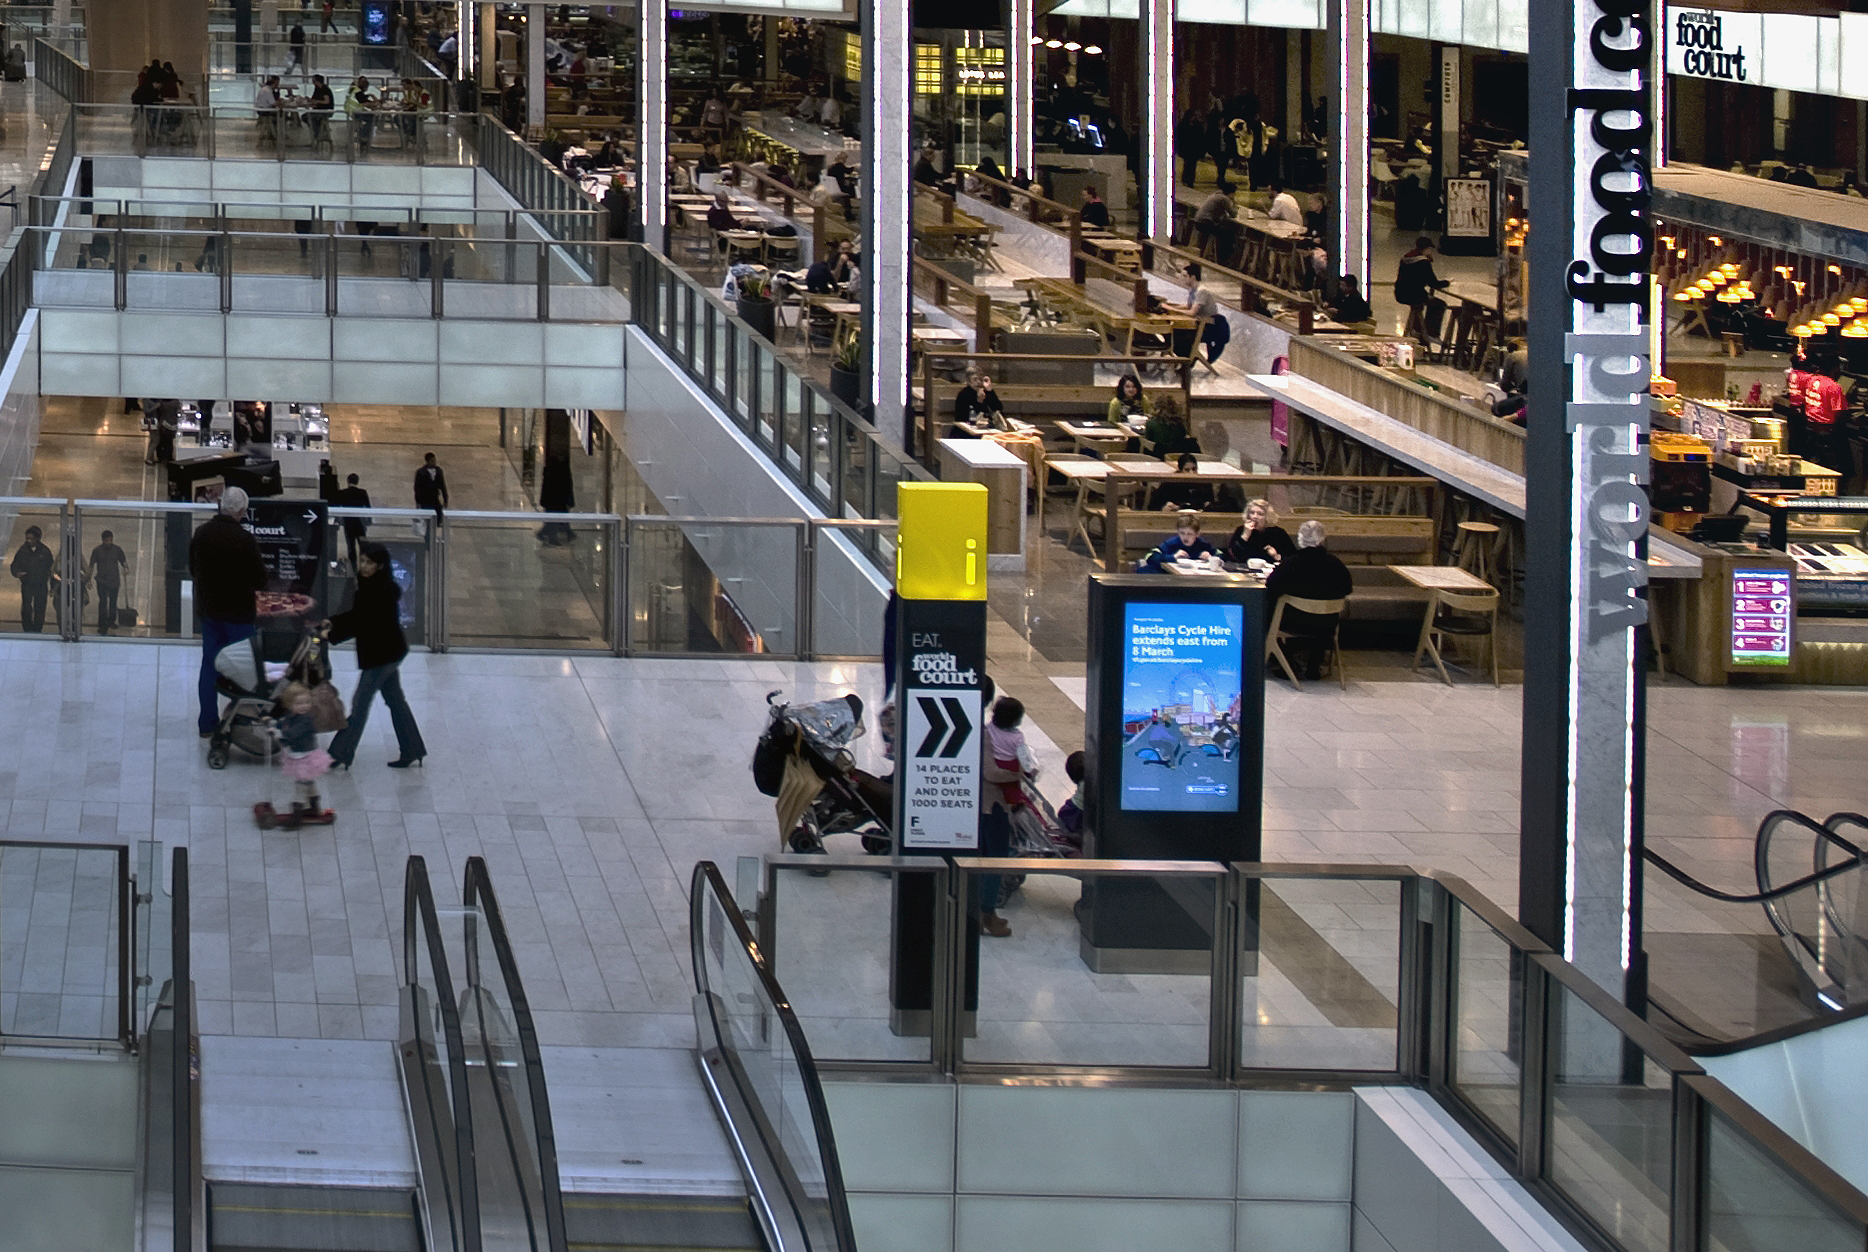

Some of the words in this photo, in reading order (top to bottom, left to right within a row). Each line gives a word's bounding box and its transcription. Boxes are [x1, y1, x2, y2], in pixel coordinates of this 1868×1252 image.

[1676, 13, 1723, 51] food
[1684, 46, 1746, 81] court
[1565, 86, 1652, 314] food
[1564, 325, 1652, 646] world
[255, 526, 286, 536] court
[1132, 624, 1176, 636] Barclays
[1178, 625, 1207, 636] Cycle
[1209, 626, 1232, 636] Hire
[912, 633, 943, 648] EAT.
[1132, 636, 1175, 646] extends
[1177, 637, 1200, 646] east
[1202, 637, 1228, 646] from
[1132, 647, 1139, 656] 8
[1141, 647, 1174, 656] March
[912, 654, 957, 672] food
[919, 667, 978, 685] court
[916, 765, 927, 774] 14
[930, 765, 971, 774] PLACES
[924, 776, 939, 785] TO
[941, 776, 962, 785] EAT
[914, 788, 938, 797] AND
[941, 788, 971, 797] OVER
[911, 799, 938, 809] 1000
[941, 799, 974, 809] SEATS
[910, 816, 920, 827] F
